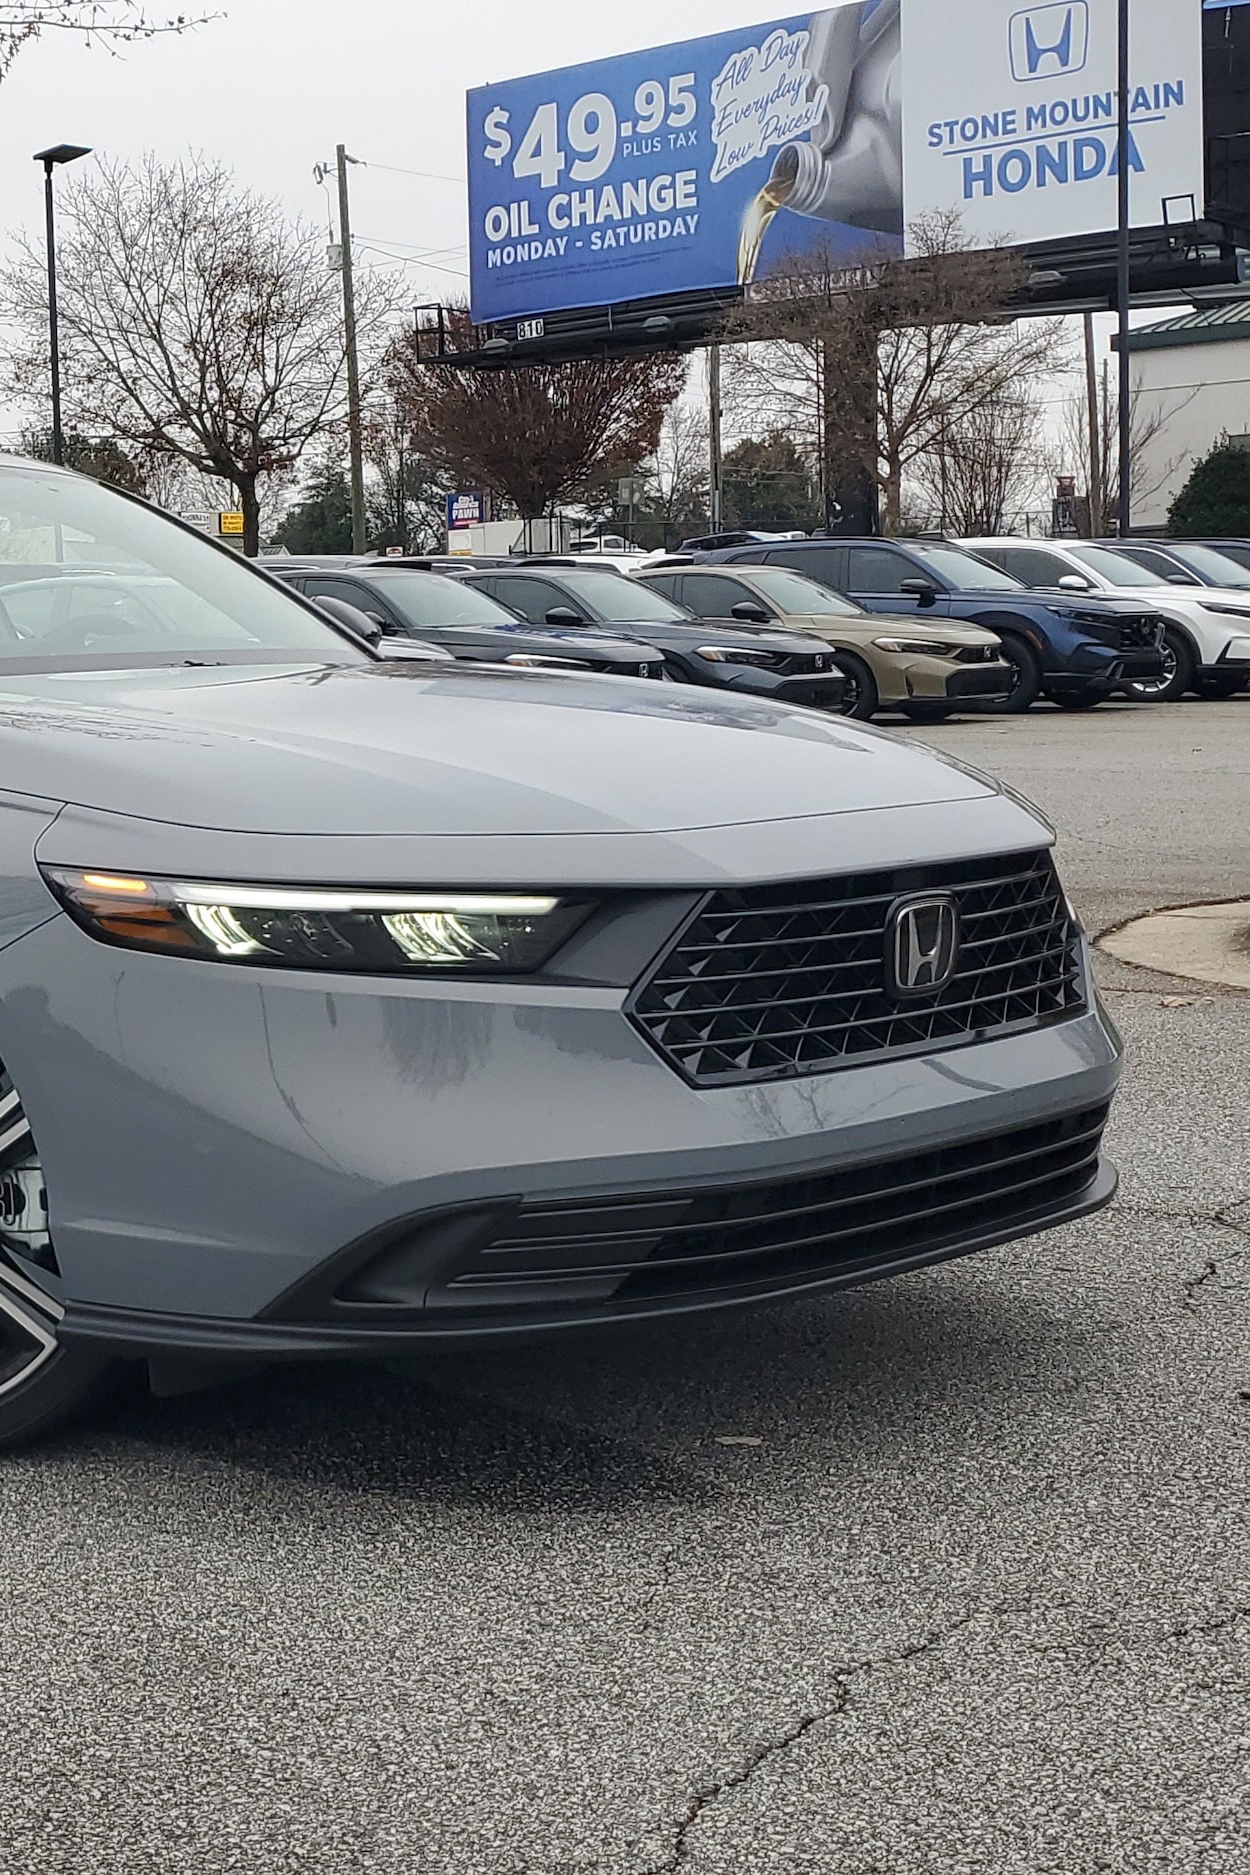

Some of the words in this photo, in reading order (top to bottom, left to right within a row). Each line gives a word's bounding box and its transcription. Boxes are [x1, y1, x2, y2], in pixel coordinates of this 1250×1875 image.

[716, 52, 754, 100] All
[760, 36, 805, 73] Day
[715, 141, 754, 176] Low
[760, 91, 824, 151] Prices!
[716, 73, 807, 138] Everyday
[927, 109, 1017, 147] STONE
[623, 137, 661, 157] PLUS
[668, 130, 697, 150] TAX
[962, 130, 1145, 199] HONDA
[485, 200, 539, 242] OIL
[548, 170, 698, 230] CHANGE
[487, 236, 568, 268] MONDAY
[590, 214, 699, 250] SATURDAY
[519, 321, 543, 338] 810
[452, 507, 480, 521] PAWN
